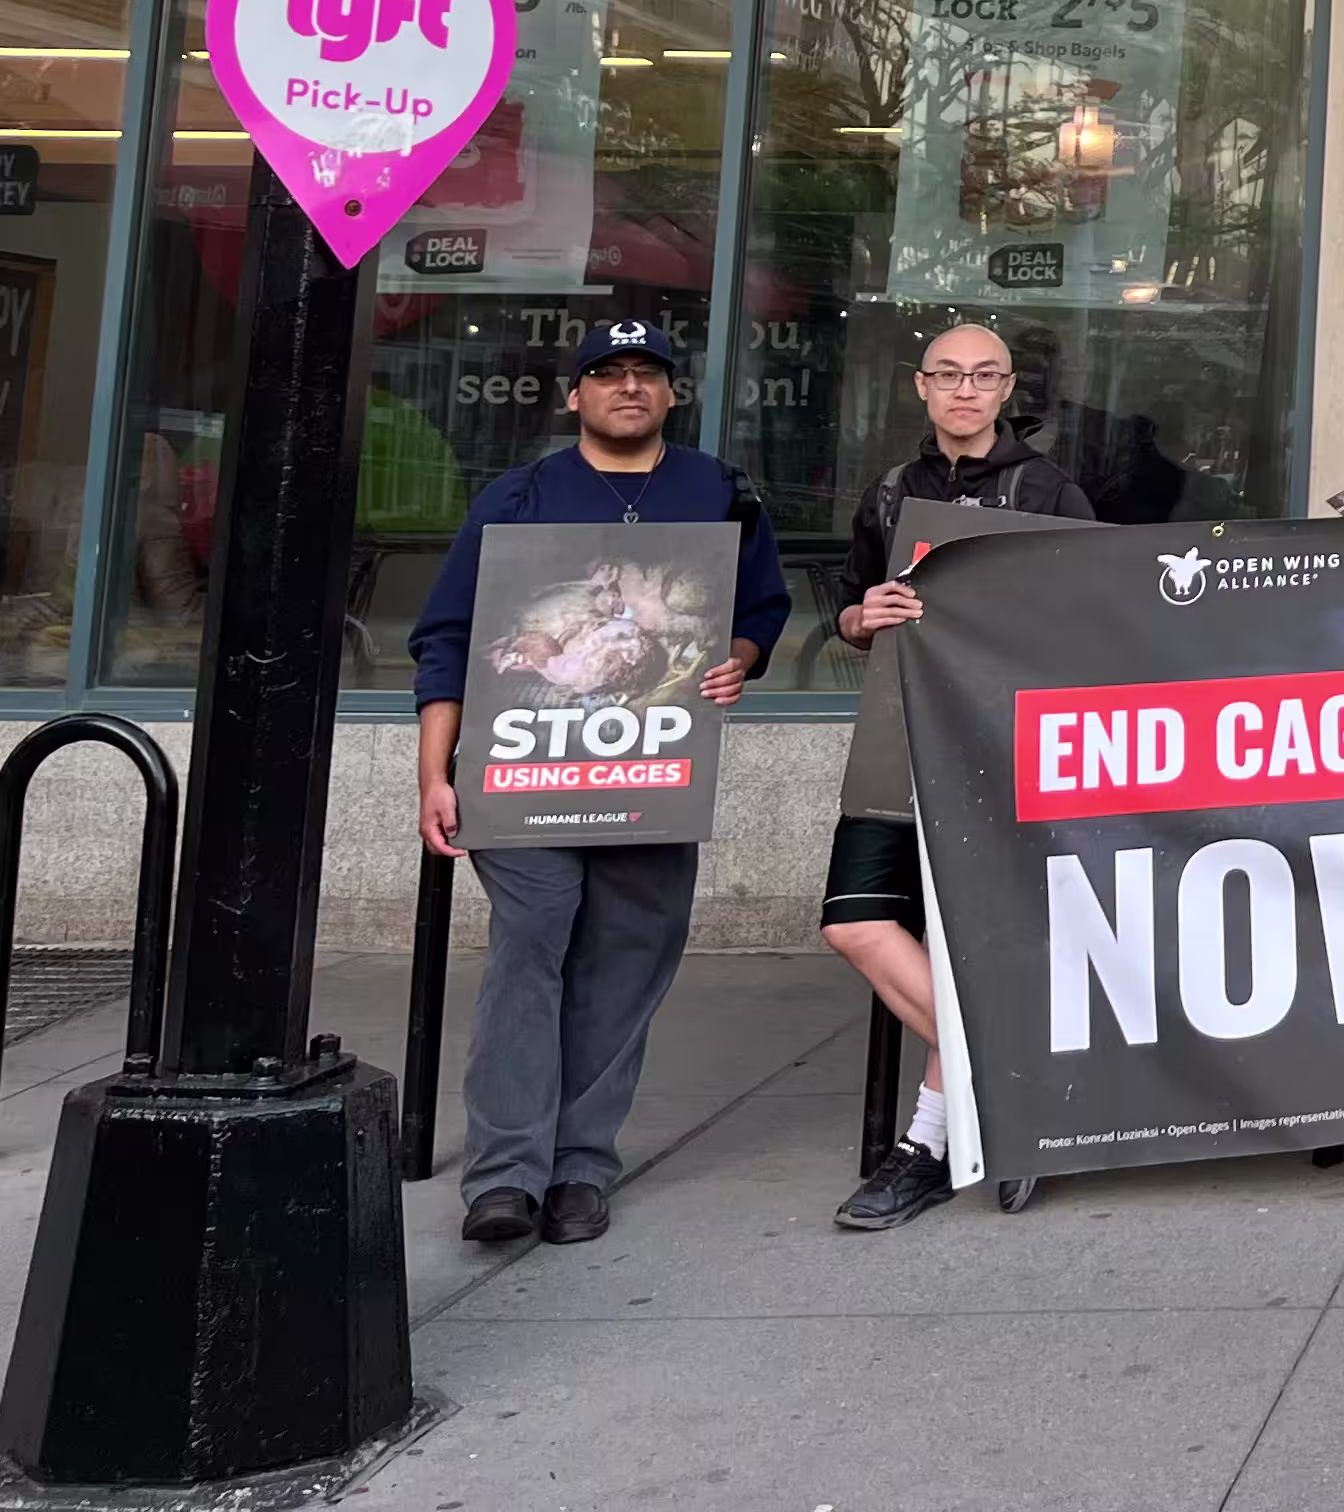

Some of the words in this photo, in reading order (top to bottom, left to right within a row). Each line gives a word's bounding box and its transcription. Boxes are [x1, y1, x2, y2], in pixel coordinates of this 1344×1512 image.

[1025, 41, 1067, 58] Shop
[1071, 43, 1126, 61] Bagels
[286, 77, 434, 125] Pick-Up
[427, 237, 479, 252] DEAL
[425, 251, 478, 268] LOCK
[1008, 250, 1057, 266] DEAL
[1008, 266, 1057, 282] LOCK
[520, 308, 690, 347] Thk
[456, 373, 541, 405] see
[1216, 556, 1274, 574] OPEN
[1284, 553, 1341, 570] WING
[489, 705, 693, 760] STOP
[1038, 706, 1187, 792] END
[492, 766, 580, 788] USING
[588, 763, 681, 785] CAGES
[529, 813, 581, 825] HUMANE
[582, 812, 627, 824] LEAGUE
[1039, 1137, 1074, 1150] Photo:
[1076, 1130, 1115, 1146] Konrad
[1168, 1124, 1197, 1138] Open
[1198, 1120, 1230, 1135] Cages
[1240, 1117, 1277, 1131] Images
